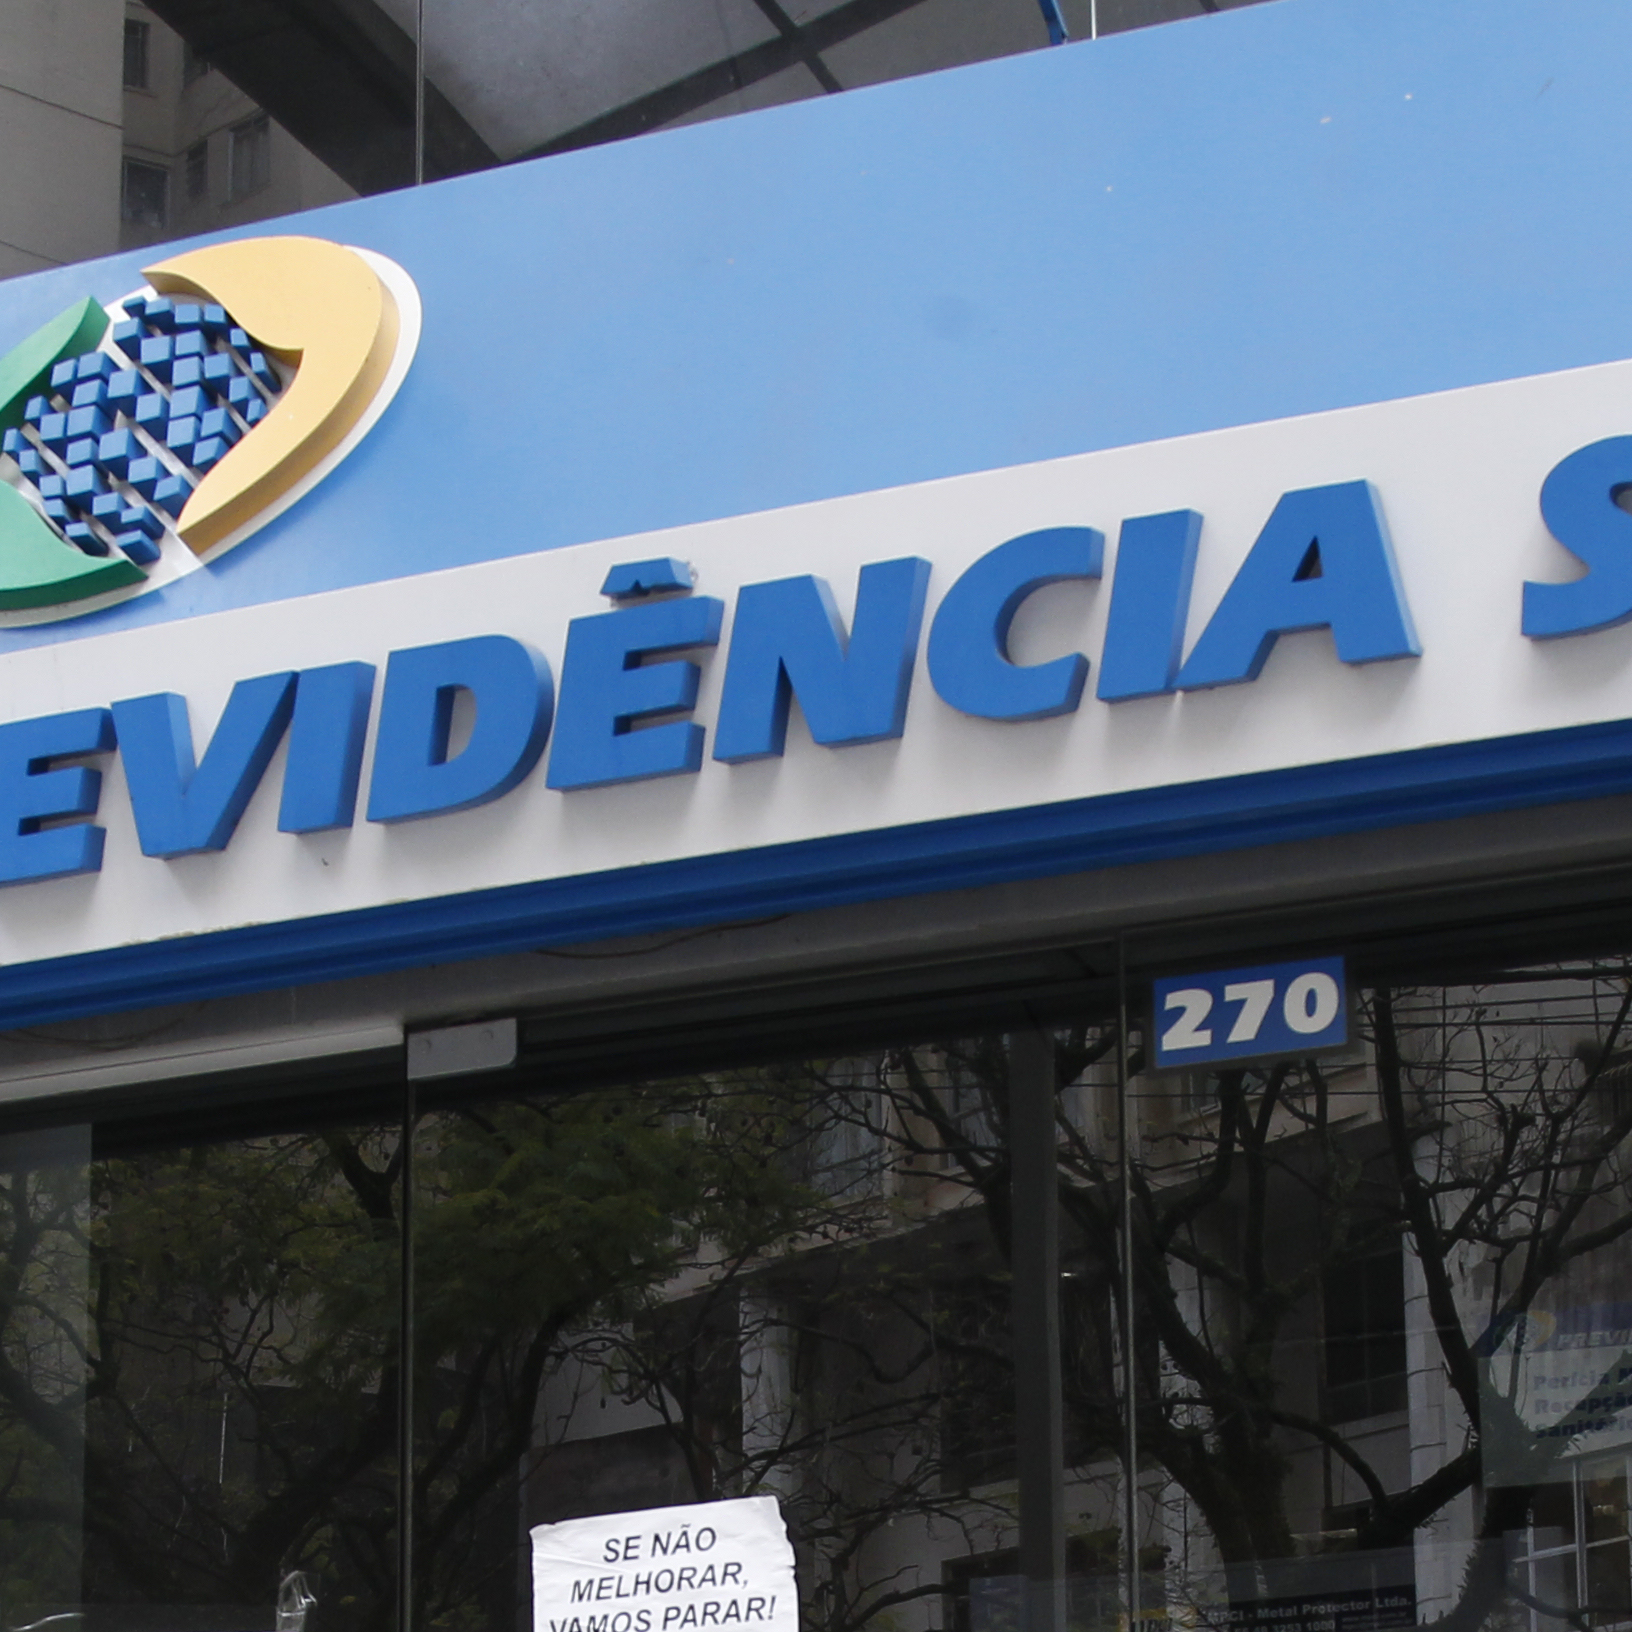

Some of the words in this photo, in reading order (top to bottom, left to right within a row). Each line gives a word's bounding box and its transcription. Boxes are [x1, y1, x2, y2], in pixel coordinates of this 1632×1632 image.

[1160, 972, 1341, 1053] 270
[602, 1536, 642, 1563] SE
[650, 1524, 717, 1557] NÃO
[570, 1562, 749, 1603] MELHORAR,
[662, 1595, 776, 1631] PARAR!
